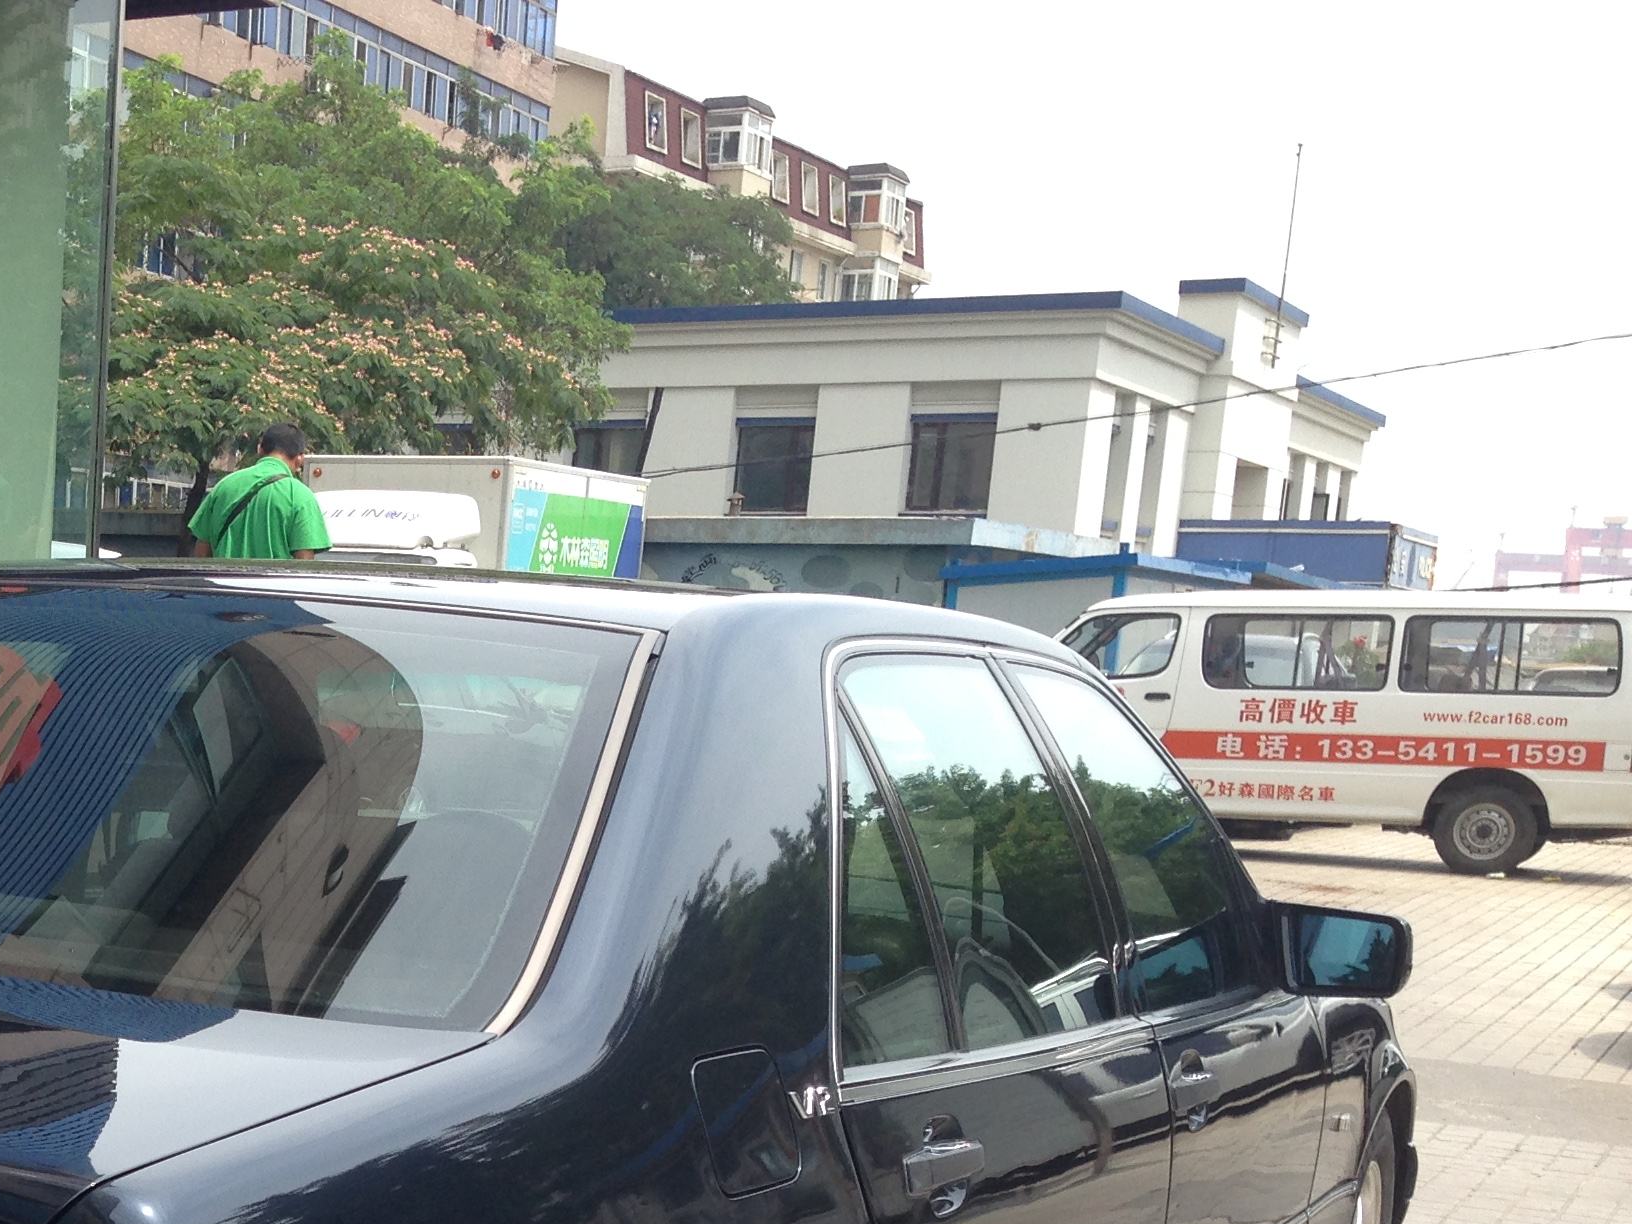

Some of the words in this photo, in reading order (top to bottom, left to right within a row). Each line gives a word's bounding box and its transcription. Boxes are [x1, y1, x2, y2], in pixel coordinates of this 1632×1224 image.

[1239, 698, 1359, 726] 高價收車
[1423, 710, 1568, 727] www.f2car168.com
[1317, 738, 1588, 766] 133-5411-1599
